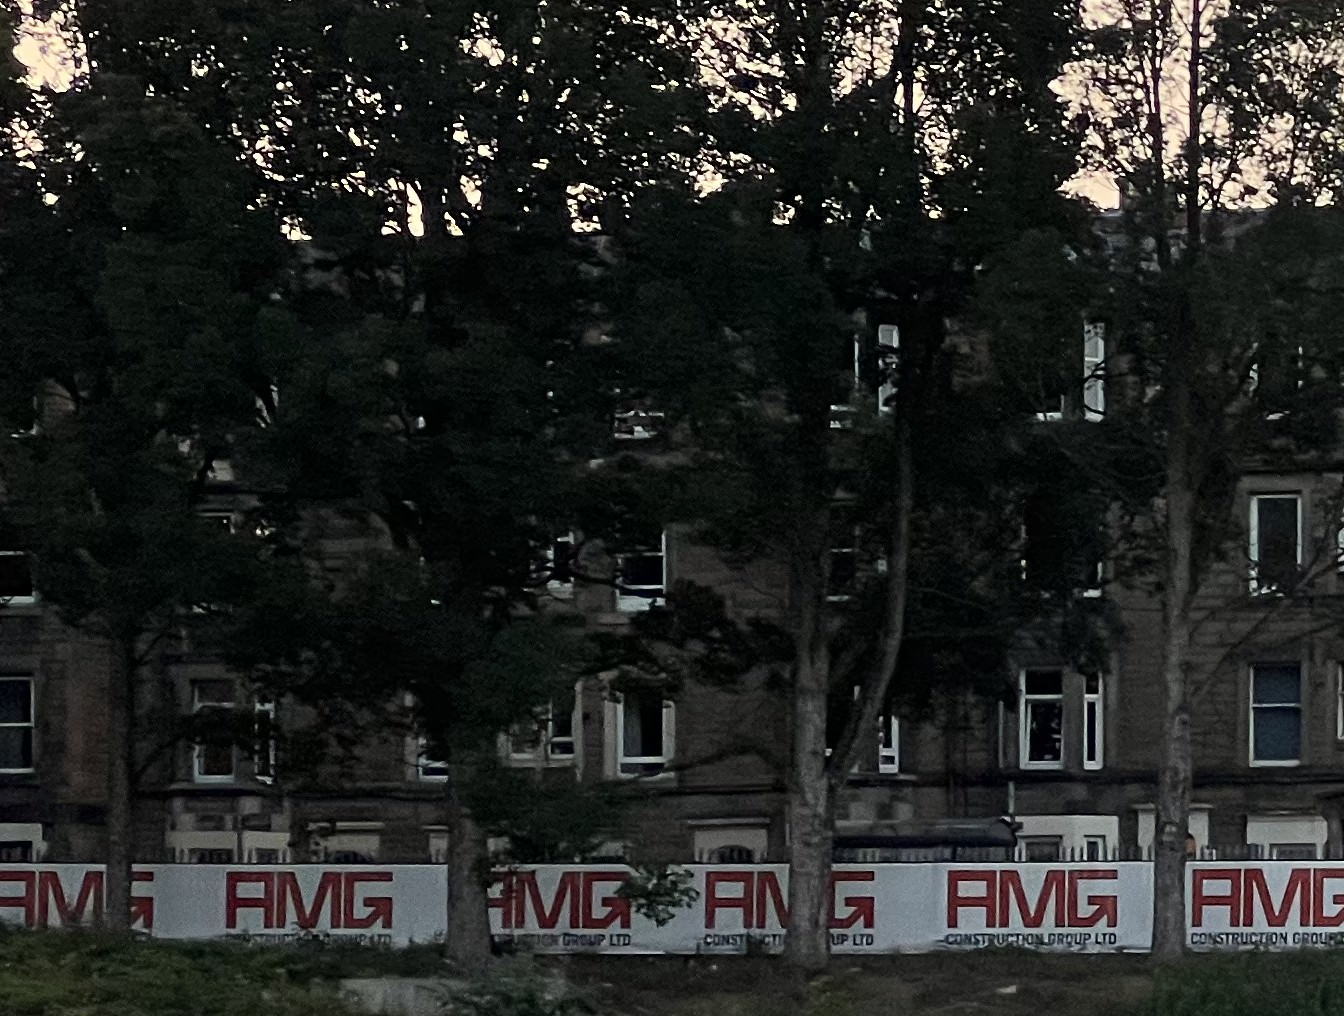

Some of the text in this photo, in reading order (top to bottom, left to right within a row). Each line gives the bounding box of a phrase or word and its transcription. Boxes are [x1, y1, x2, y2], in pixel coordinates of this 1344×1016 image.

[226, 871, 393, 929] AMG
[947, 870, 1118, 928] AMG
[609, 934, 631, 946] LTD
[853, 934, 874, 946] LTD
[945, 933, 1117, 946] CONSTRUCTION GROUP LTD
[1191, 932, 1288, 945] CONSTRUCTION
